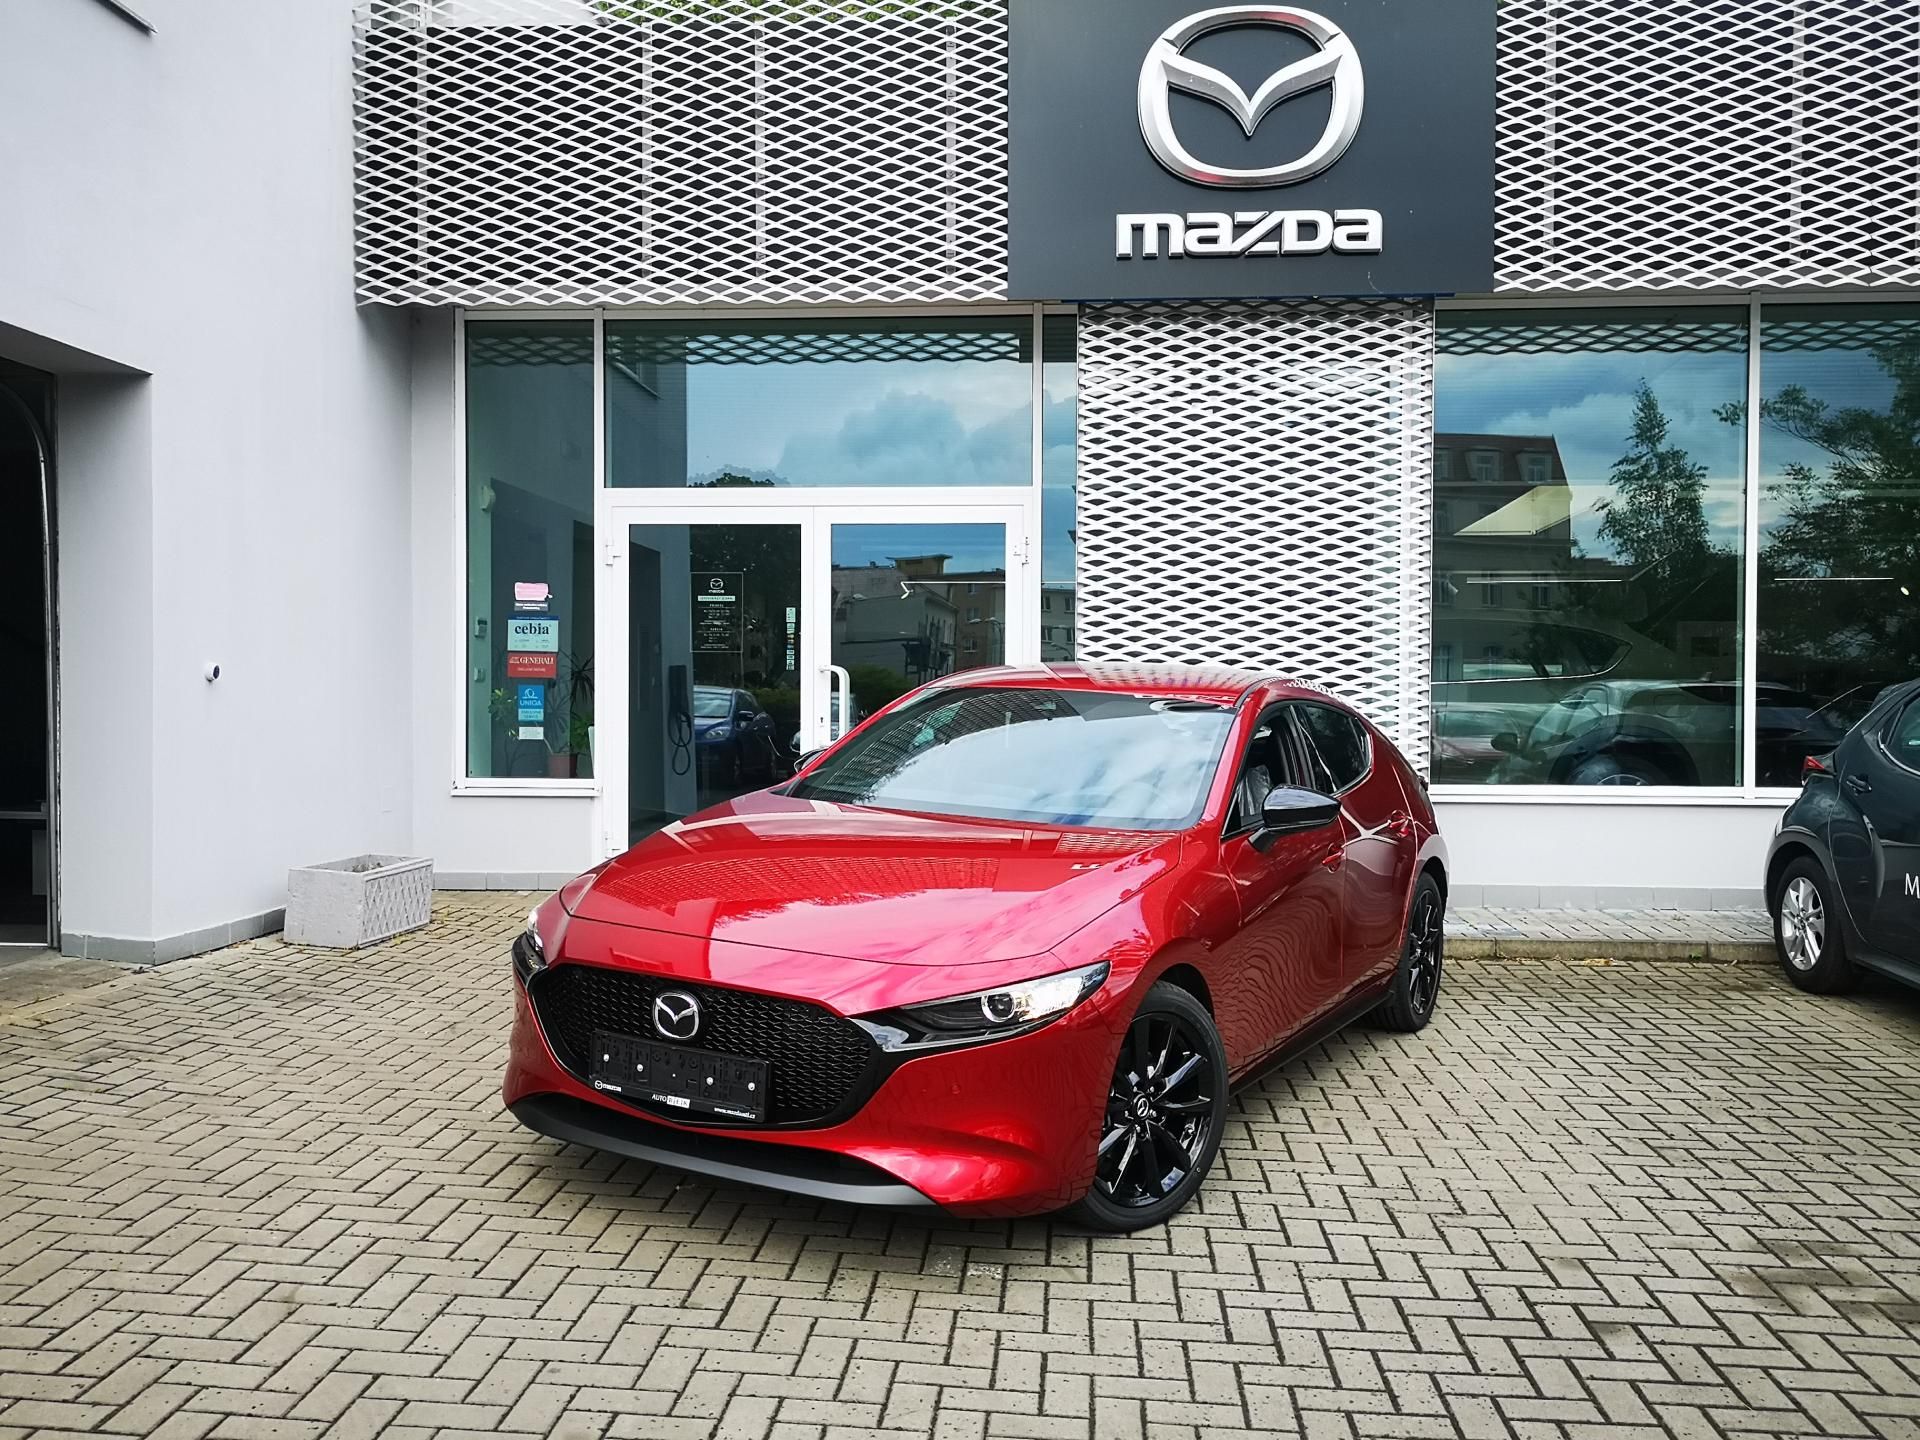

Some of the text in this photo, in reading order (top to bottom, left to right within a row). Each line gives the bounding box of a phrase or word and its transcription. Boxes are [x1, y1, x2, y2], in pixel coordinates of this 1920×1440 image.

[515, 623, 549, 635] cebia
[519, 656, 554, 665] GENERALI
[652, 1093, 667, 1102] AUTO
